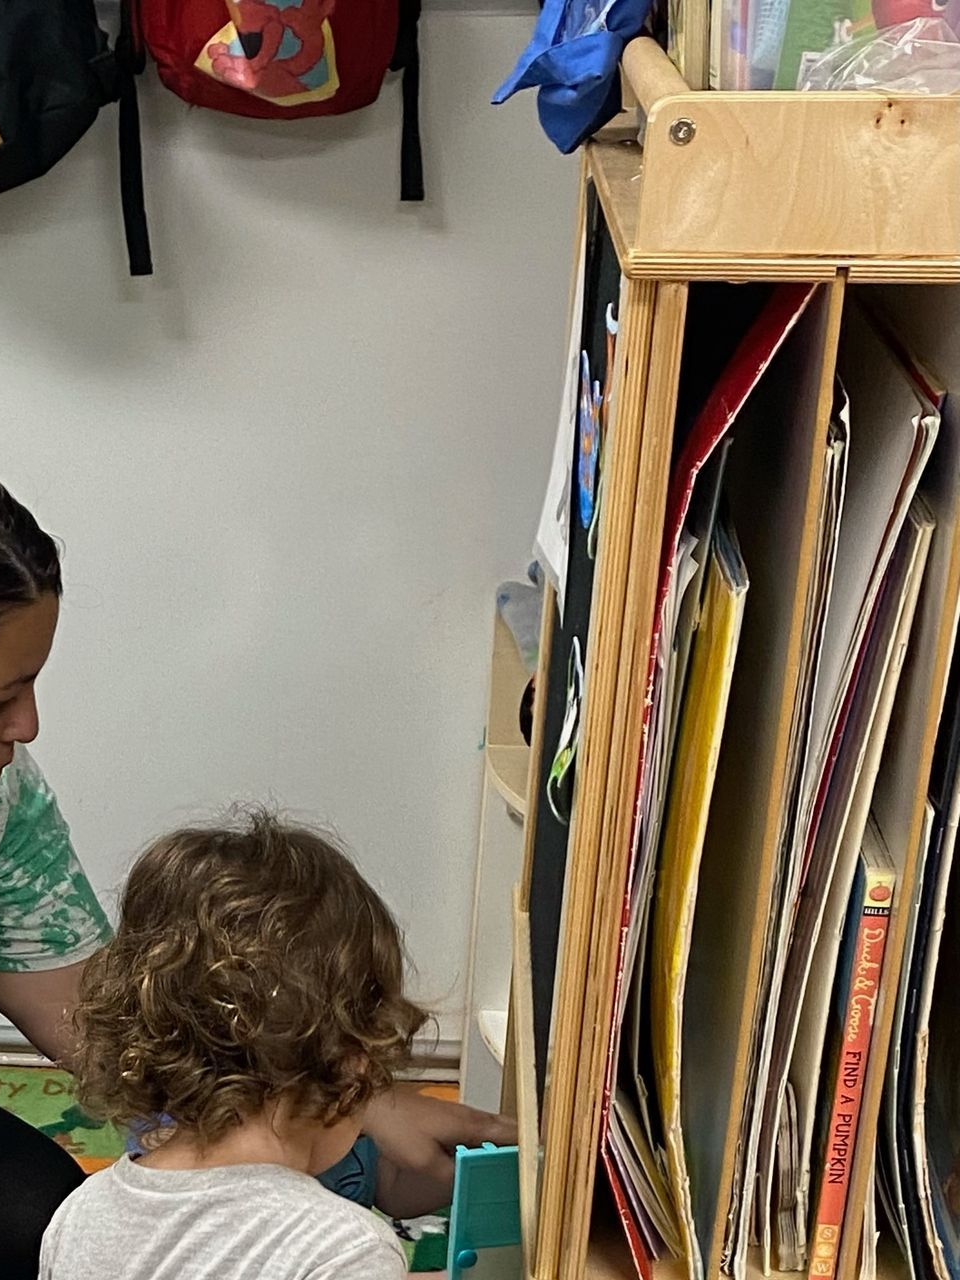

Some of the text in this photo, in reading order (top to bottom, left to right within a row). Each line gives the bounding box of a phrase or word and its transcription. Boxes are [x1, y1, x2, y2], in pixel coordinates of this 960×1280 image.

[828, 928, 885, 1184] Duck & Goose FIND A PUMPKIN
